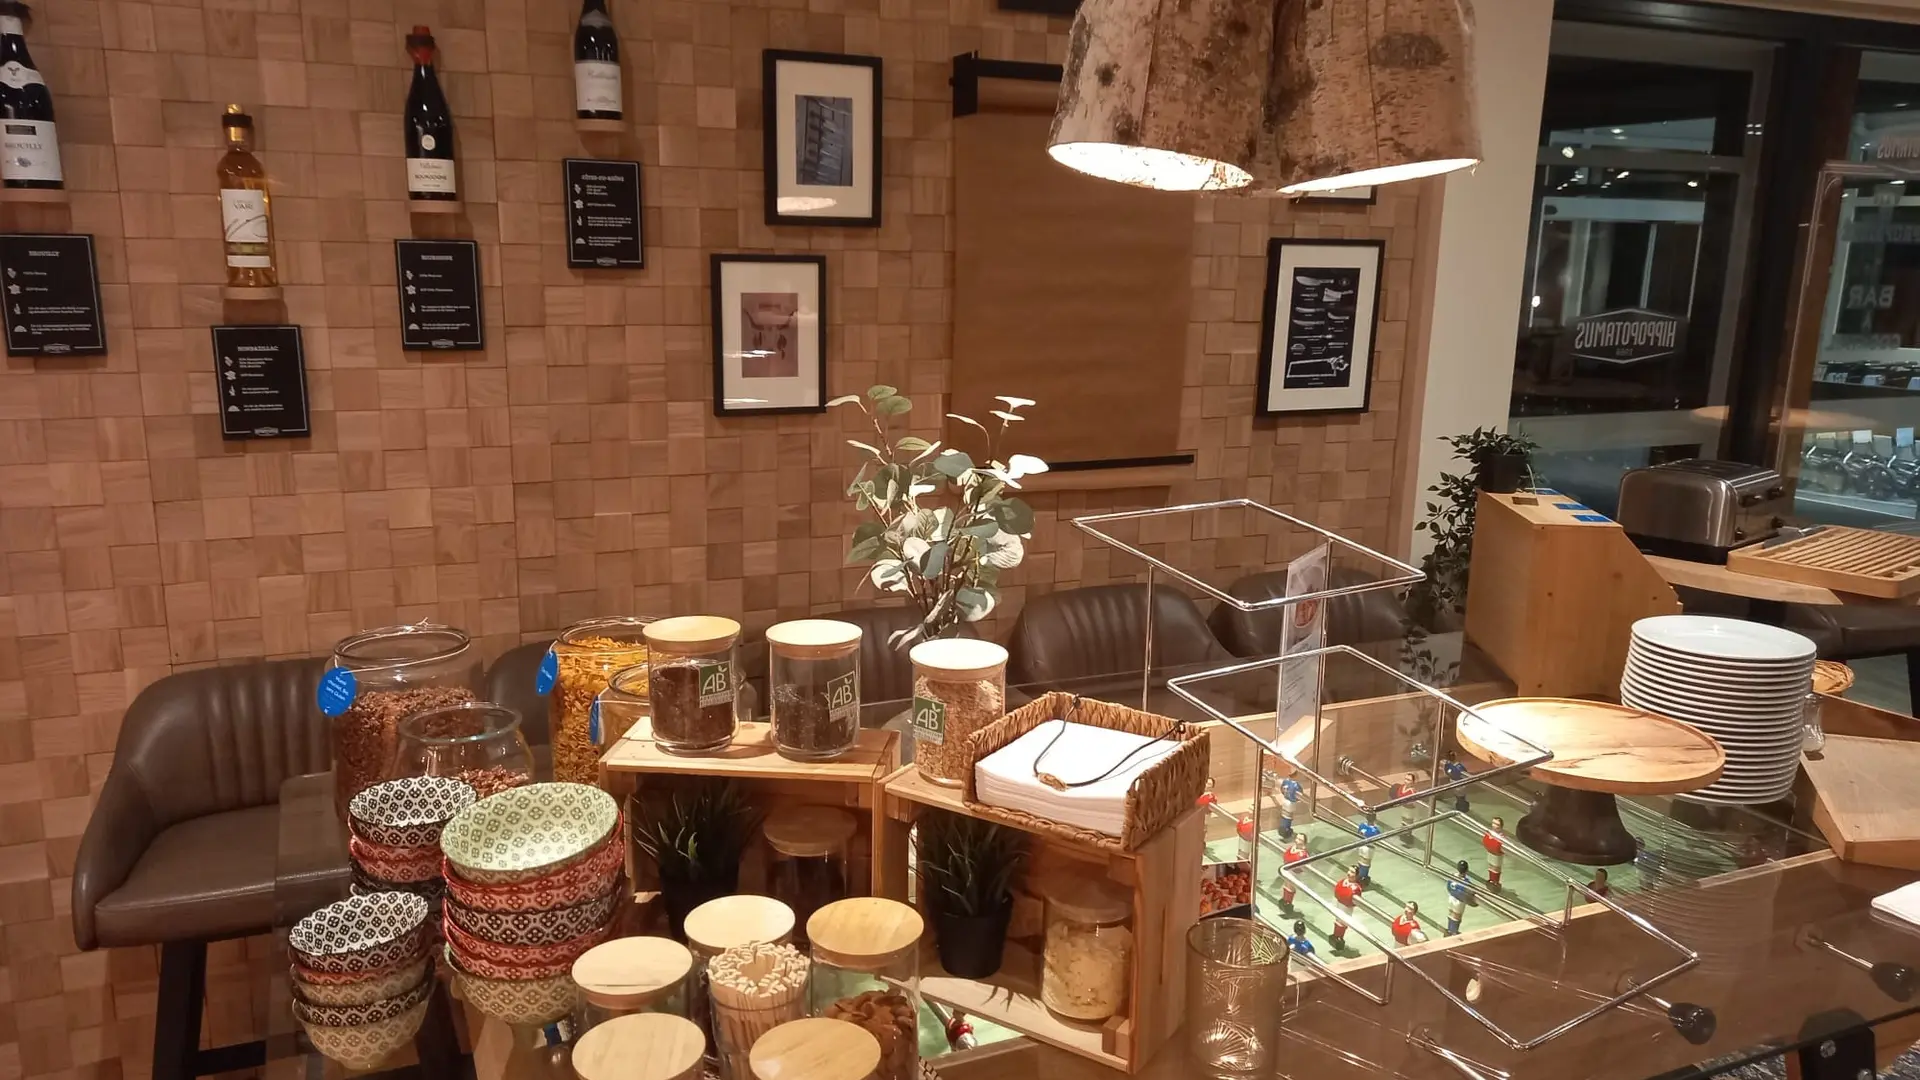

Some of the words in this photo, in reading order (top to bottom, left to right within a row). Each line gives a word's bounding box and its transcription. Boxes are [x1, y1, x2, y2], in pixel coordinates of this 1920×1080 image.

[702, 672, 726, 694] AB
[832, 684, 852, 709] AB
[916, 708, 938, 730] AB
